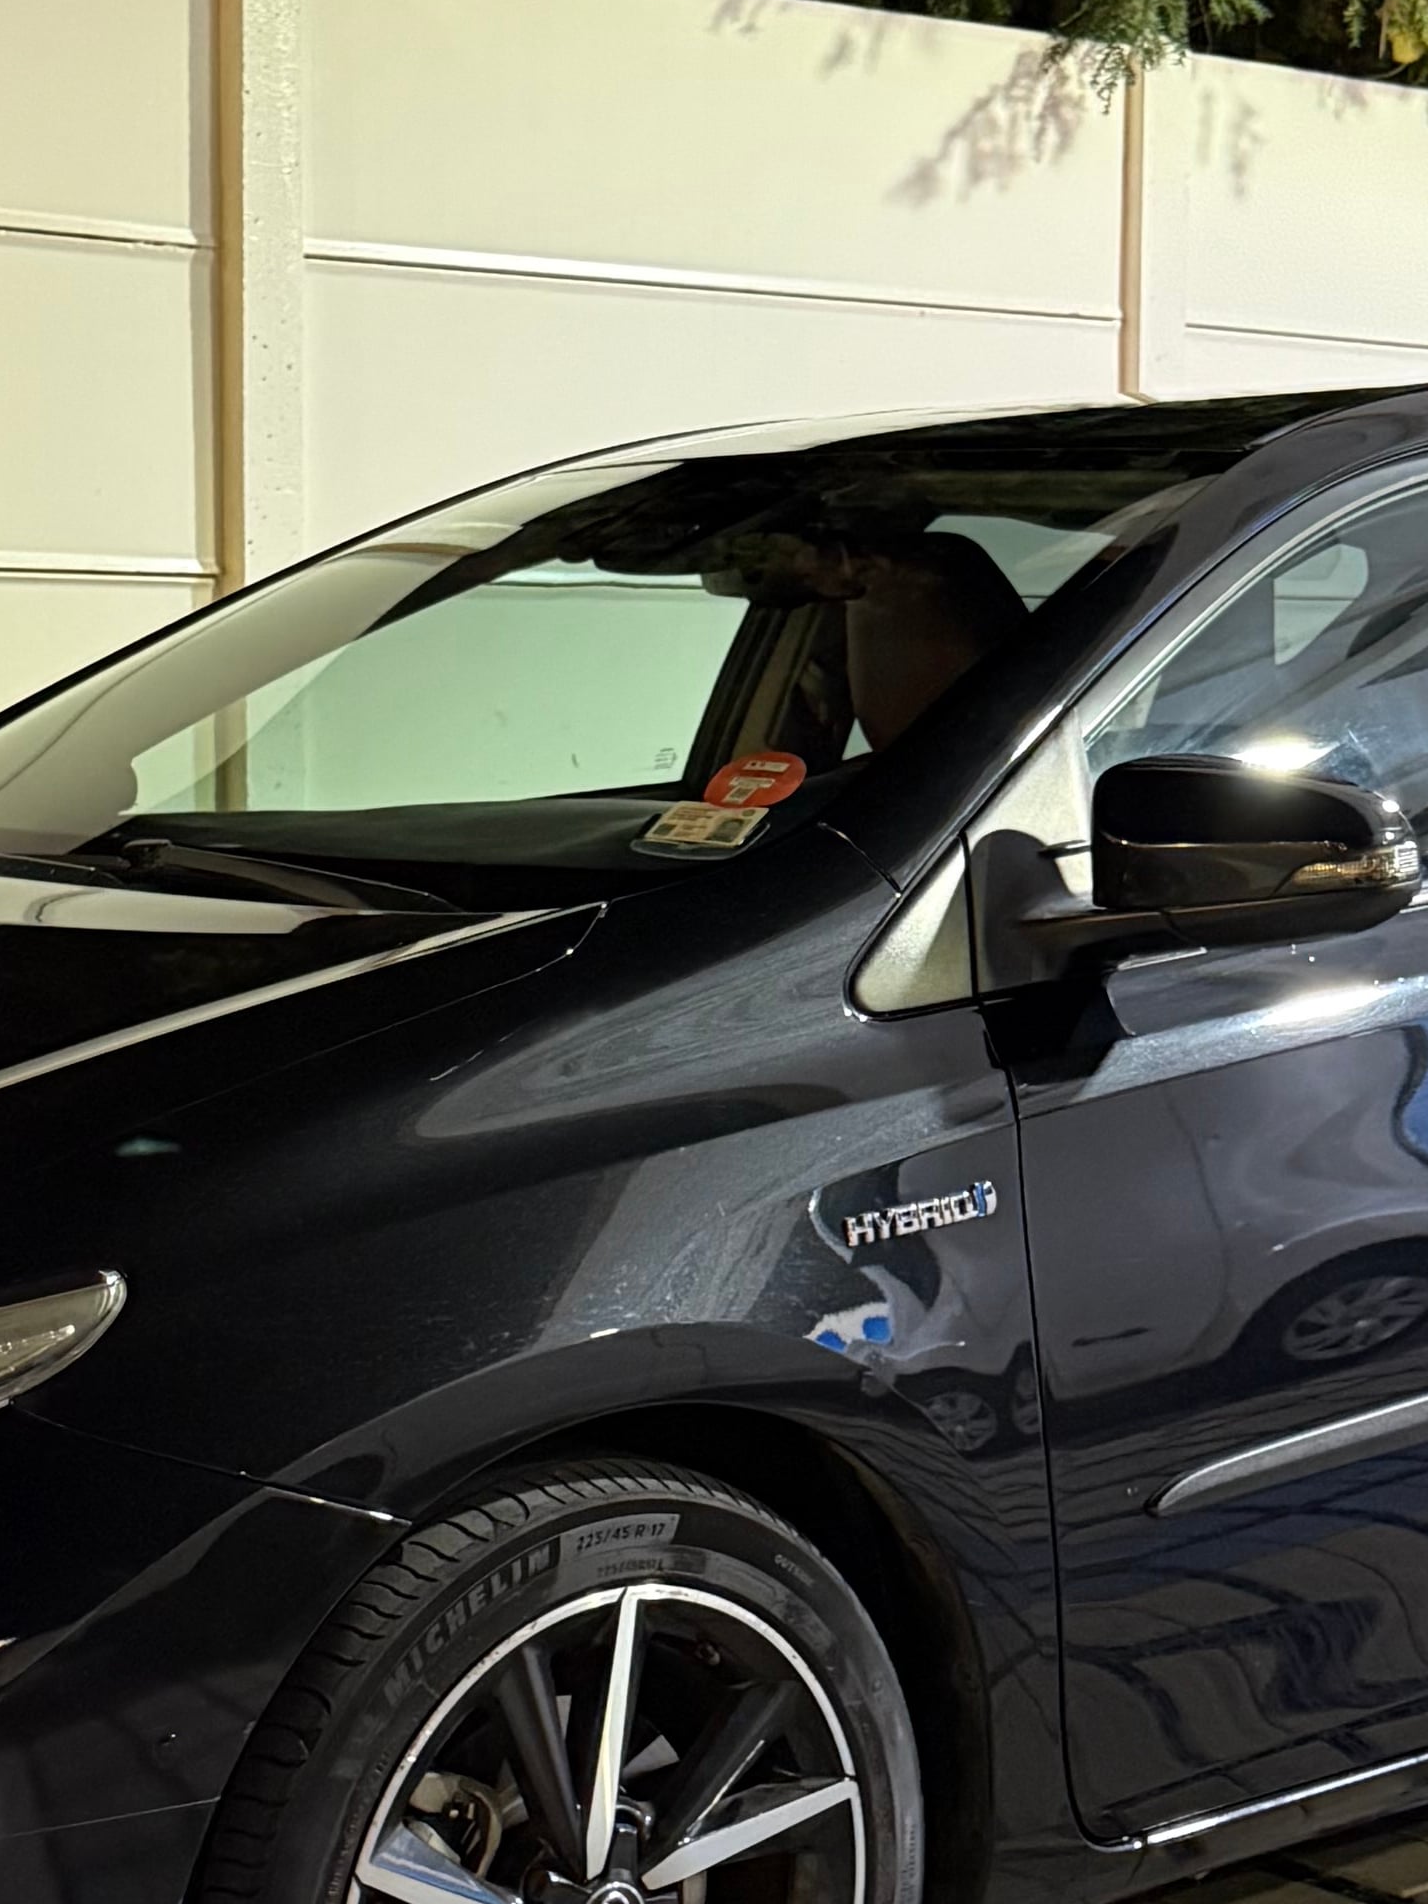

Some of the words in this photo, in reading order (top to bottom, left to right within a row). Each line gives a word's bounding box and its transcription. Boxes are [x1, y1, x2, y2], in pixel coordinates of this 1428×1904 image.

[843, 1190, 978, 1247] HYBRID
[577, 1527, 630, 1551] 225/45
[383, 1543, 551, 1707] MICHELIN
